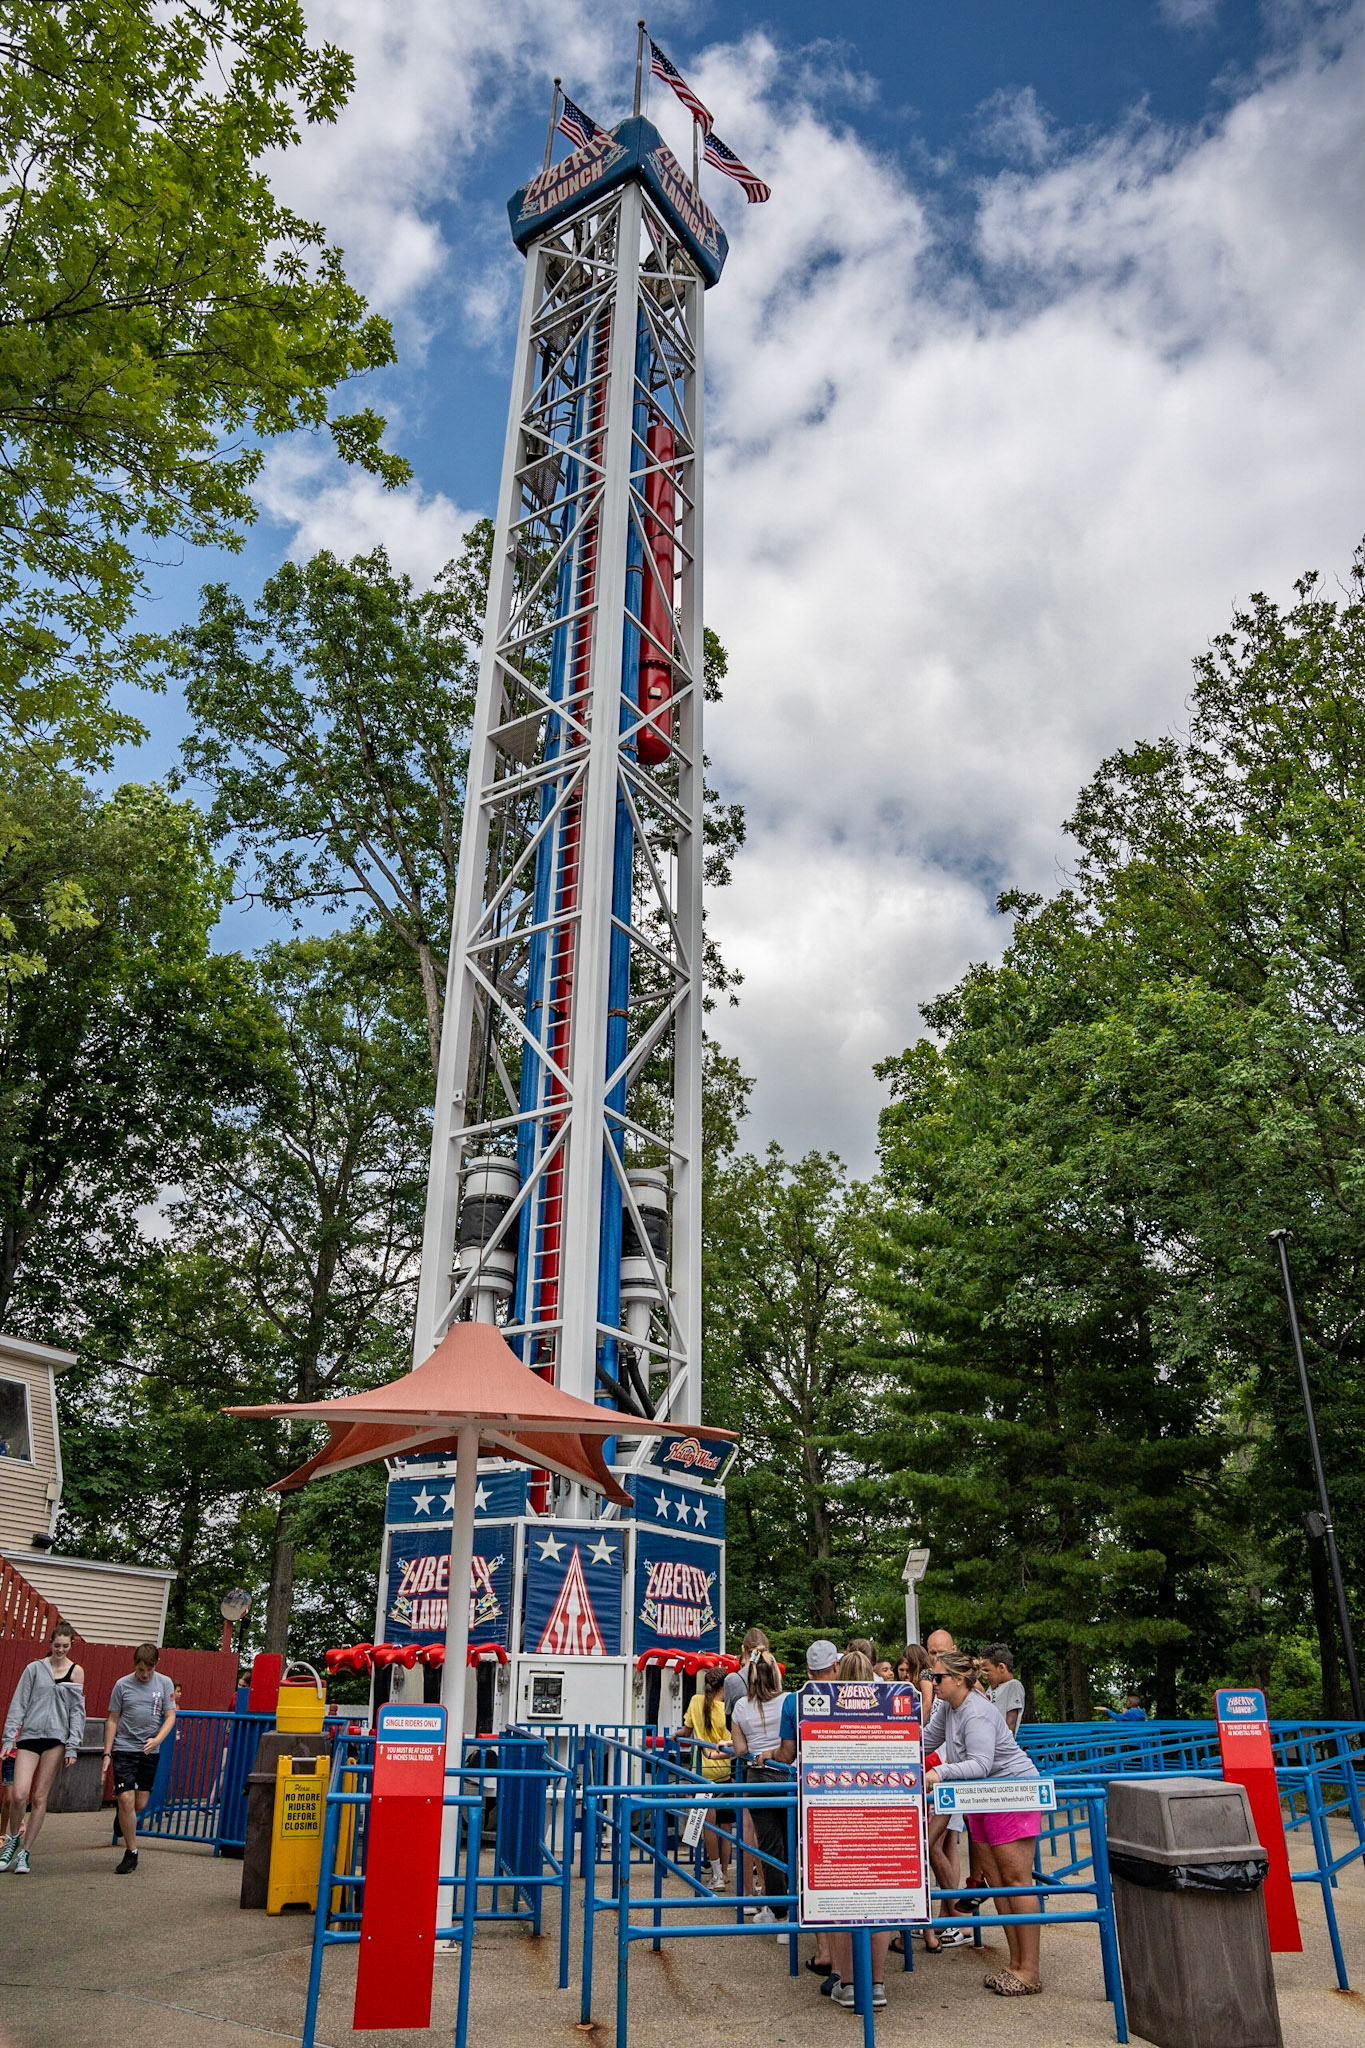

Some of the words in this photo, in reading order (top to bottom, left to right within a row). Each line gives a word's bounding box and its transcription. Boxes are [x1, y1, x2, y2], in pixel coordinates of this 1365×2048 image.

[522, 134, 620, 204] LIBERTY
[538, 160, 604, 214] LAUNCH
[654, 145, 718, 242] LIBERTY
[661, 172, 707, 246] LAUNCH
[663, 1442, 697, 1468] Holiday
[696, 1450, 721, 1470] World
[397, 1555, 494, 1597] LIBEY
[646, 1561, 711, 1605] LIBERTY
[409, 1598, 476, 1631] LAUNH
[657, 1603, 701, 1639] LAUNCH
[838, 1685, 877, 1700] LIBERTY
[845, 1699, 870, 1710] LAUNCH
[298, 1793, 320, 1801] MORE
[284, 1822, 317, 1830] CLOSING
[288, 1812, 316, 1820] BEFORE
[692, 1811, 704, 1840] TEMPORARILY
